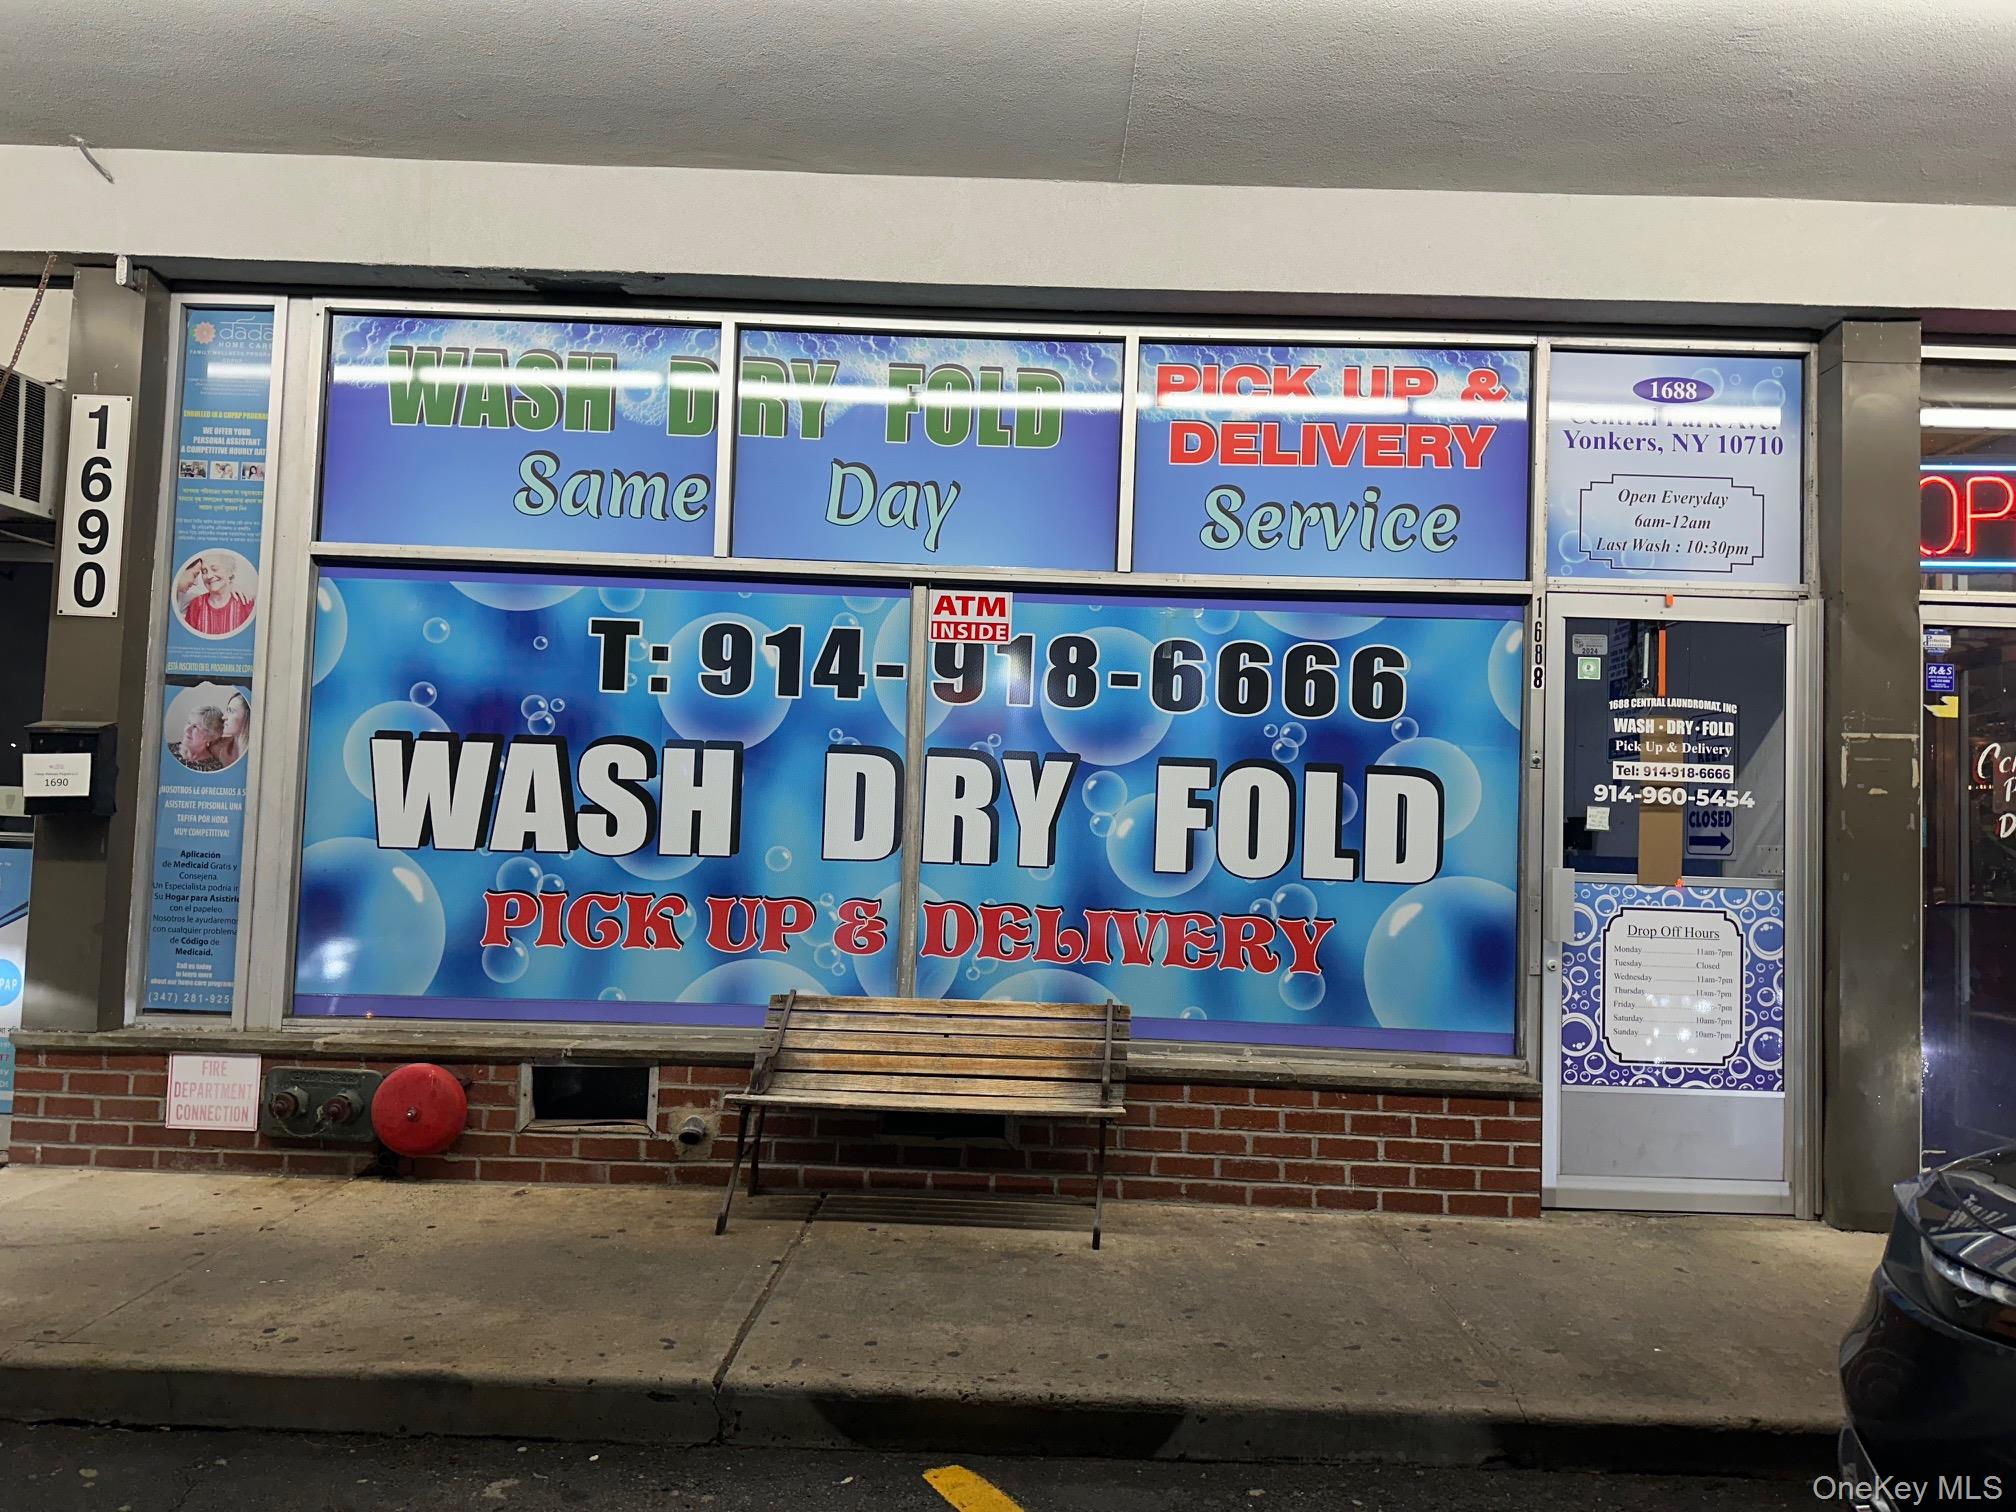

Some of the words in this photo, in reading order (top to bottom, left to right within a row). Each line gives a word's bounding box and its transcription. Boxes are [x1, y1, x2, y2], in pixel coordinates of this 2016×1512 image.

[1155, 363, 1321, 406] PICK
[1341, 365, 1438, 407] UP
[1460, 368, 1510, 405] &
[1650, 381, 1698, 400] 1688
[387, 345, 617, 432] WASH
[885, 362, 1064, 448] FOLD
[203, 426, 213, 435] WE
[214, 427, 233, 435] OFFER
[234, 428, 251, 436] YOUR
[193, 436, 225, 445] PERSONAL
[226, 437, 261, 446] ASSISTANT
[1169, 420, 1497, 469] DELIVERY
[1563, 429, 1664, 455] Yonkers,
[1672, 433, 1709, 453] NY
[1718, 434, 1784, 455] 10710
[186, 446, 228, 455] COMPETITIVE
[228, 447, 253, 456] HOURLY
[512, 450, 711, 522] Same
[825, 458, 961, 553] Day
[1199, 484, 1460, 553] Service
[1617, 488, 1658, 507] Open
[1661, 490, 1729, 509] Everyday
[74, 404, 112, 608] 1690
[1634, 514, 1712, 529] 6am-12am
[1596, 537, 1628, 552] Last
[1632, 538, 1671, 553] Wash
[1687, 539, 1750, 556] 10:30pm
[933, 595, 1007, 617] ATM
[932, 622, 1008, 640] INSIDE
[588, 617, 671, 694] T:
[699, 621, 1408, 722] 914-918-6666
[1928, 665, 1953, 676] R&S
[1609, 699, 1629, 710] 1688
[1631, 697, 1666, 708] CENTRAL
[1667, 698, 1721, 713] LAUNDROMAT,
[1723, 702, 1737, 714] INC
[1614, 718, 1655, 734] WASH
[1666, 719, 1694, 735] DRY
[1702, 720, 1735, 737] FOLD
[1615, 740, 1641, 752] Pick
[1645, 742, 1663, 755] Up
[1666, 742, 1678, 753] &
[1682, 742, 1732, 757] Delivery
[1616, 765, 1639, 777] Tel:
[1643, 766, 1731, 780] 914-918-6666
[45, 778, 69, 787] 1690
[193, 786, 200, 794] LE
[201, 787, 237, 796] OFRECEMOS
[1593, 784, 1755, 809] 914-960-5454
[164, 800, 196, 809] ASISTENTE
[197, 801, 228, 810] PERSONAL
[229, 802, 242, 811] UNA
[369, 729, 744, 857] WASH
[1152, 756, 1445, 884] FOLD
[198, 814, 210, 823] POR
[211, 815, 228, 824] HORA
[1688, 810, 1732, 828] CLOSED
[174, 827, 187, 836] MUY
[162, 860, 172, 868] de
[173, 861, 209, 869] Medicaid
[210, 862, 231, 870] Gratis
[153, 881, 163, 889] Un
[165, 881, 206, 890] Especialista
[154, 892, 164, 900] Su
[165, 893, 189, 902] Hogar
[193, 905, 222, 913] papeleo
[153, 914, 186, 922] Nosotros
[187, 914, 194, 923] le
[168, 926, 202, 934] cualquier
[203, 927, 238, 936] problema
[481, 889, 689, 951] PICK
[705, 896, 816, 955] UP
[832, 898, 888, 956] &
[920, 900, 1337, 975] DELIVERY
[1627, 924, 1657, 939] Drop
[1660, 925, 1681, 936] Off
[1685, 926, 1720, 939] Hours
[169, 936, 179, 944] de
[180, 937, 209, 946] Código
[175, 947, 213, 957] Medicaid.
[1614, 945, 1642, 954] Monday
[1614, 959, 1642, 968] Tuesday
[1696, 961, 1720, 970] Closed
[1614, 972, 1652, 982] Wednesday
[1614, 986, 1645, 995] Thursday
[148, 992, 178, 1003] (347)
[1613, 1000, 1636, 1010] Friday
[1613, 1014, 1643, 1023] Saturday
[1613, 1027, 1639, 1036] Sunday
[201, 1060, 228, 1077] FIRE
[174, 1082, 253, 1100] DEPARTMENT
[176, 1104, 249, 1122] CONNECTION
